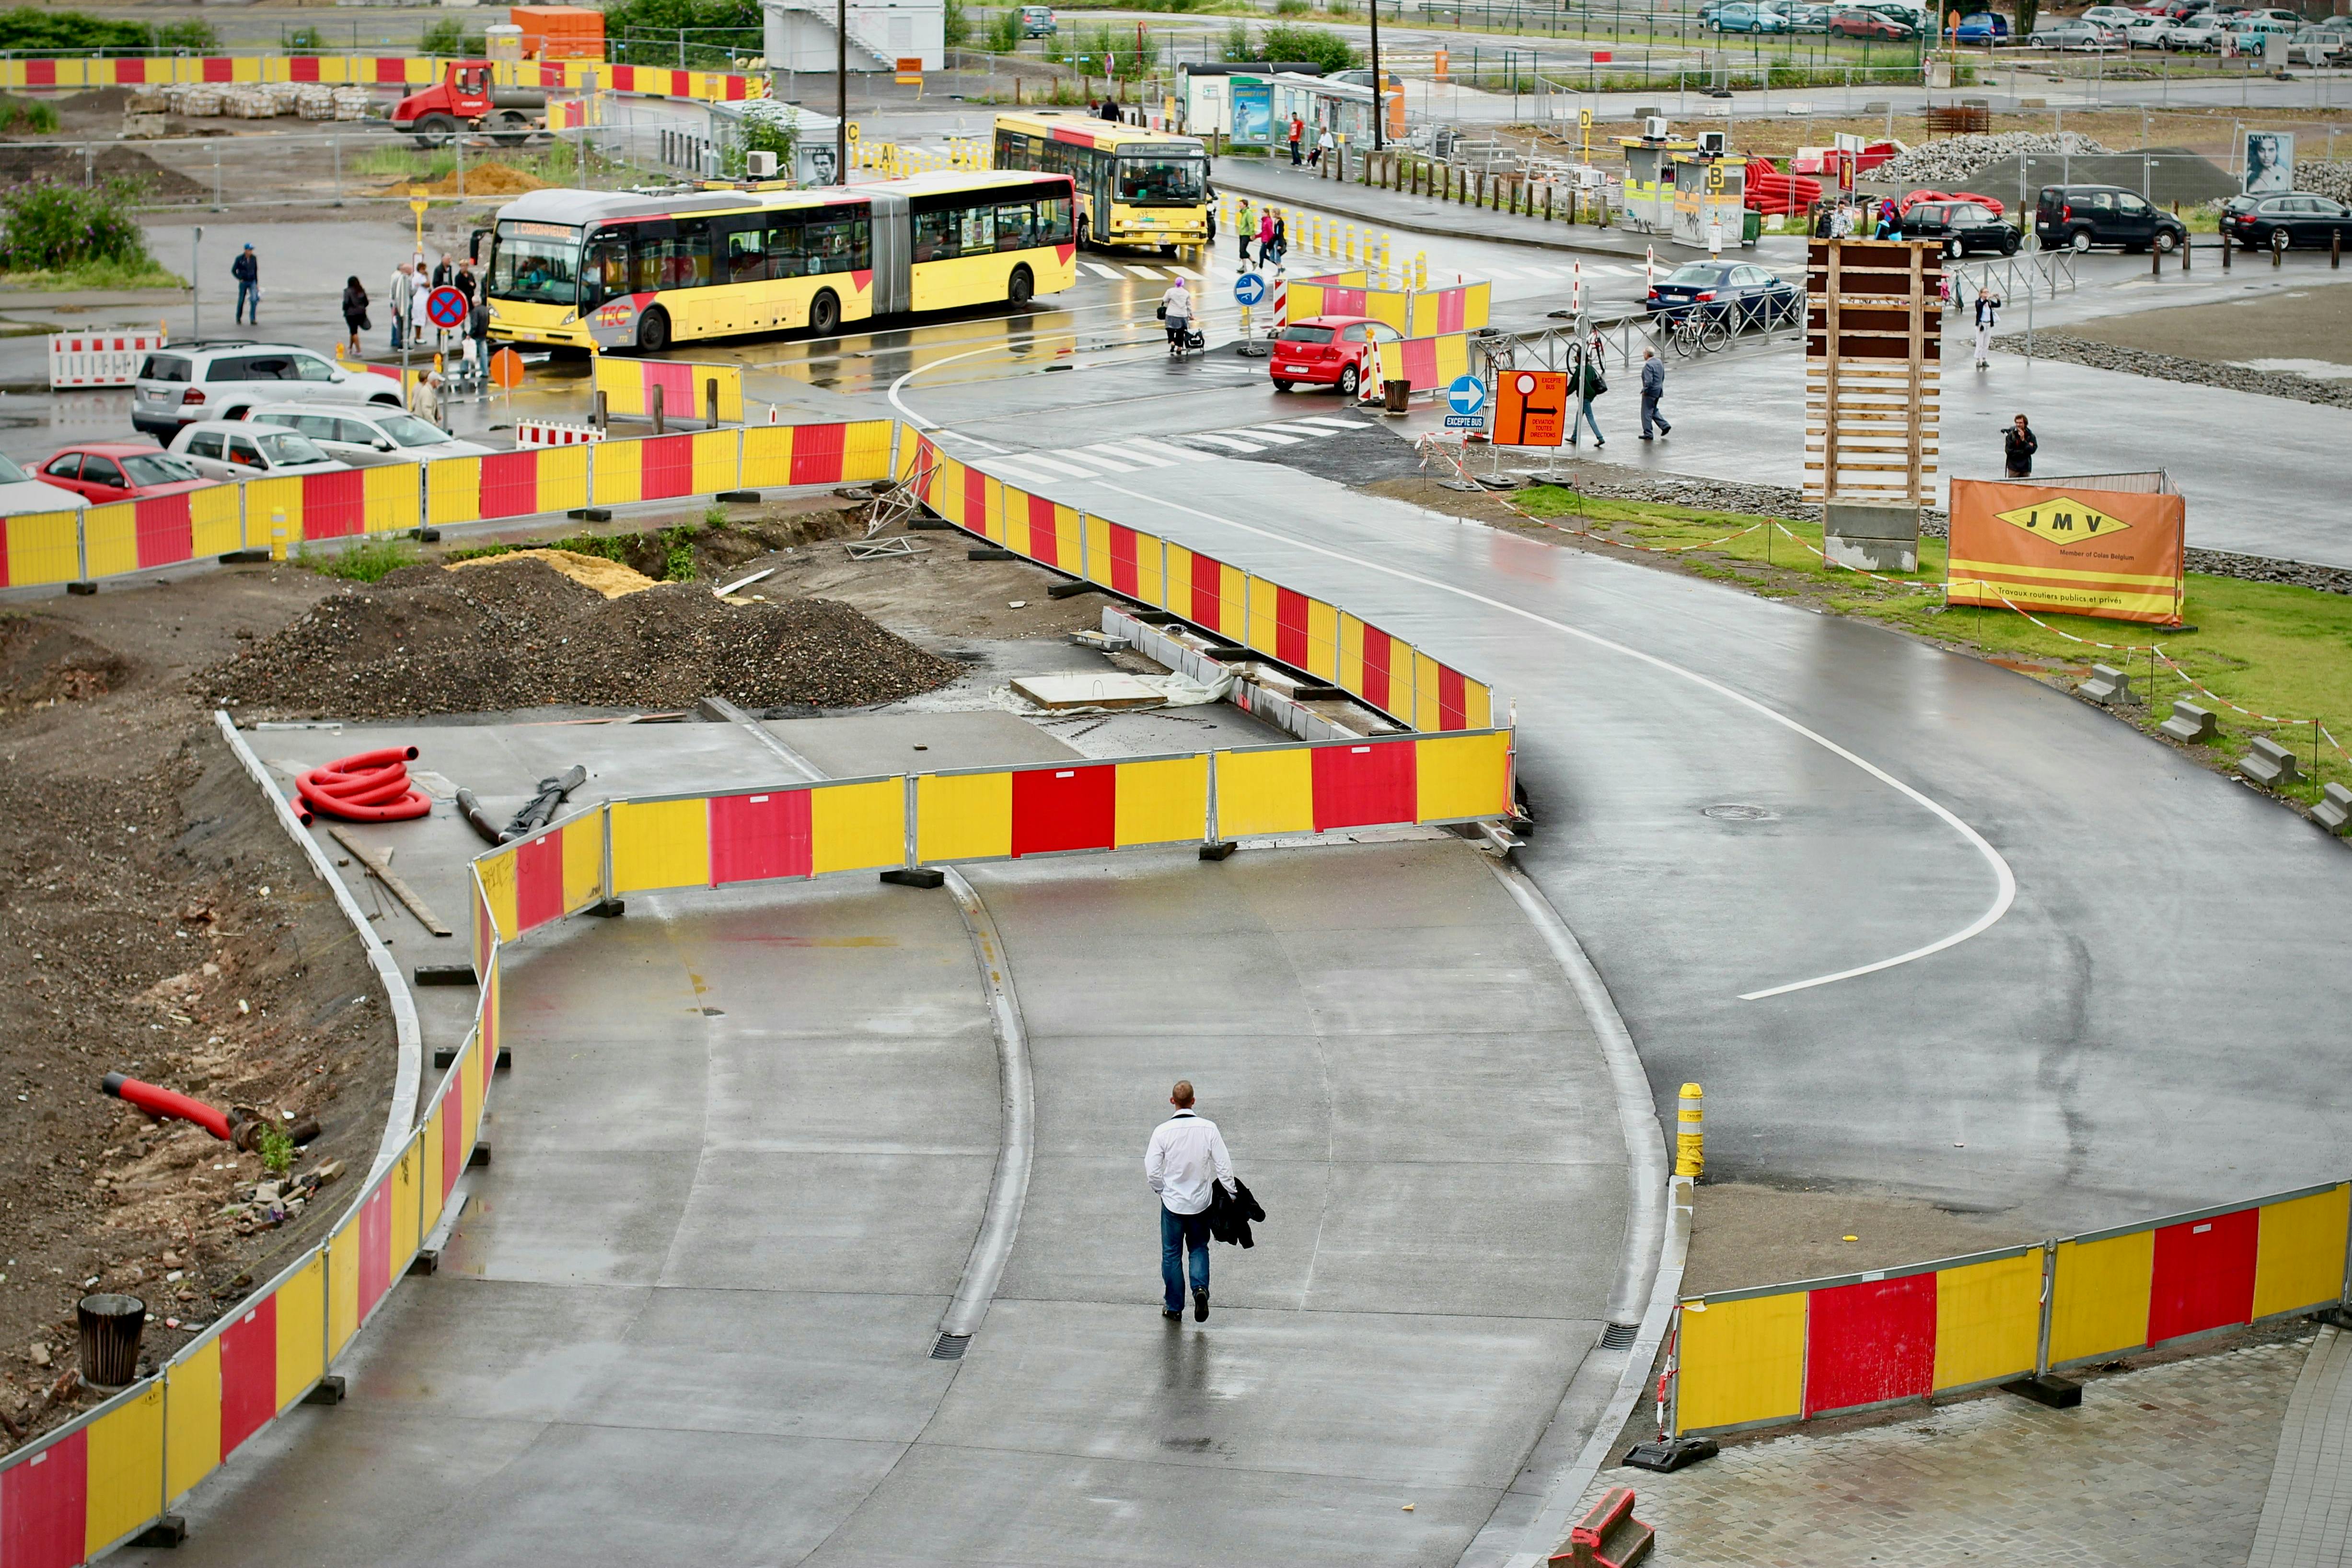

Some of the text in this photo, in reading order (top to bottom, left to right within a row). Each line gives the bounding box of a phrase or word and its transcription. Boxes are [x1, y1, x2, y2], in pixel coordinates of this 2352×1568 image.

[1581, 111, 1589, 126] D
[848, 125, 857, 140] C
[882, 145, 890, 163] A
[1711, 168, 1722, 185] B
[514, 222, 571, 238] 1 CORONMEUSE
[601, 305, 631, 327] TEC
[1447, 417, 1482, 426] EXCEPTE BUS
[1998, 587, 2028, 596] Travaux
[2030, 592, 2057, 600] routiers
